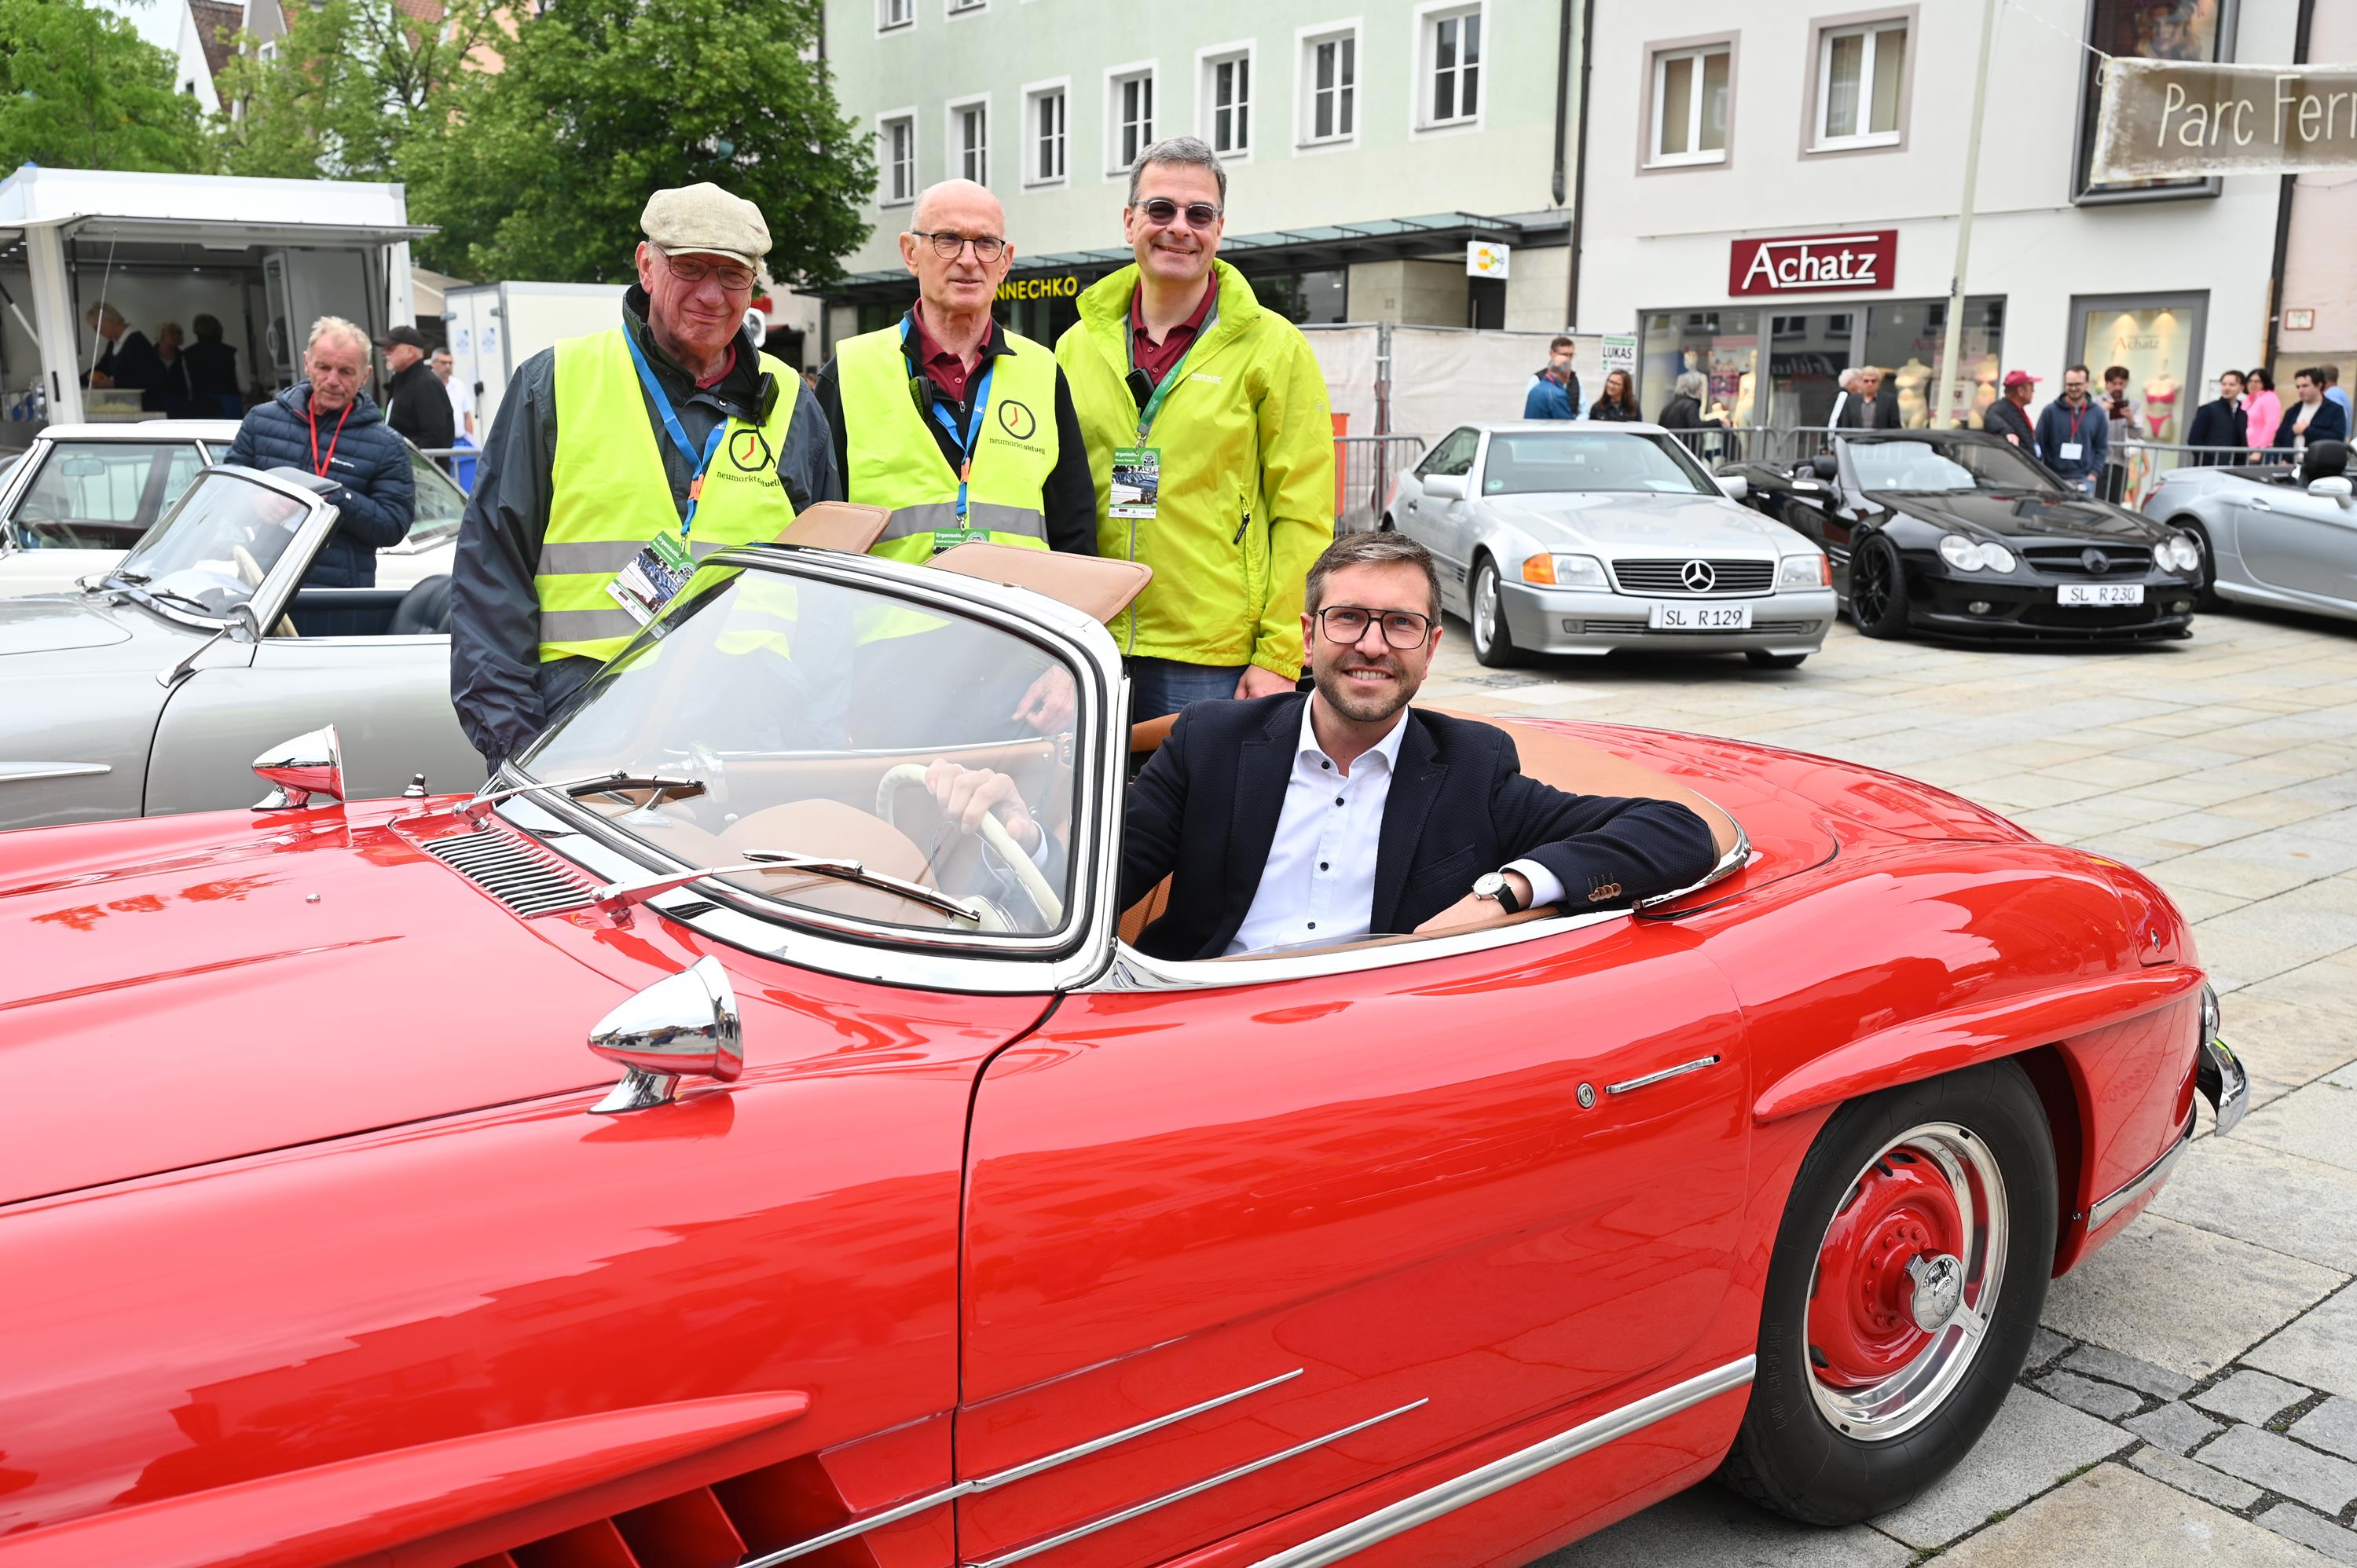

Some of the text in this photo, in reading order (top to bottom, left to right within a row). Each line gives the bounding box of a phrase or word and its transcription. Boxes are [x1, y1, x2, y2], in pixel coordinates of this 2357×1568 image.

[2157, 82, 2254, 148] Parc
[1741, 242, 1878, 290] Achatz
[1603, 346, 1633, 359] LUKAS
[717, 471, 780, 488] neumarktatuell
[2071, 588, 2135, 602] SL R 230
[1666, 610, 1743, 626] SL R 129
